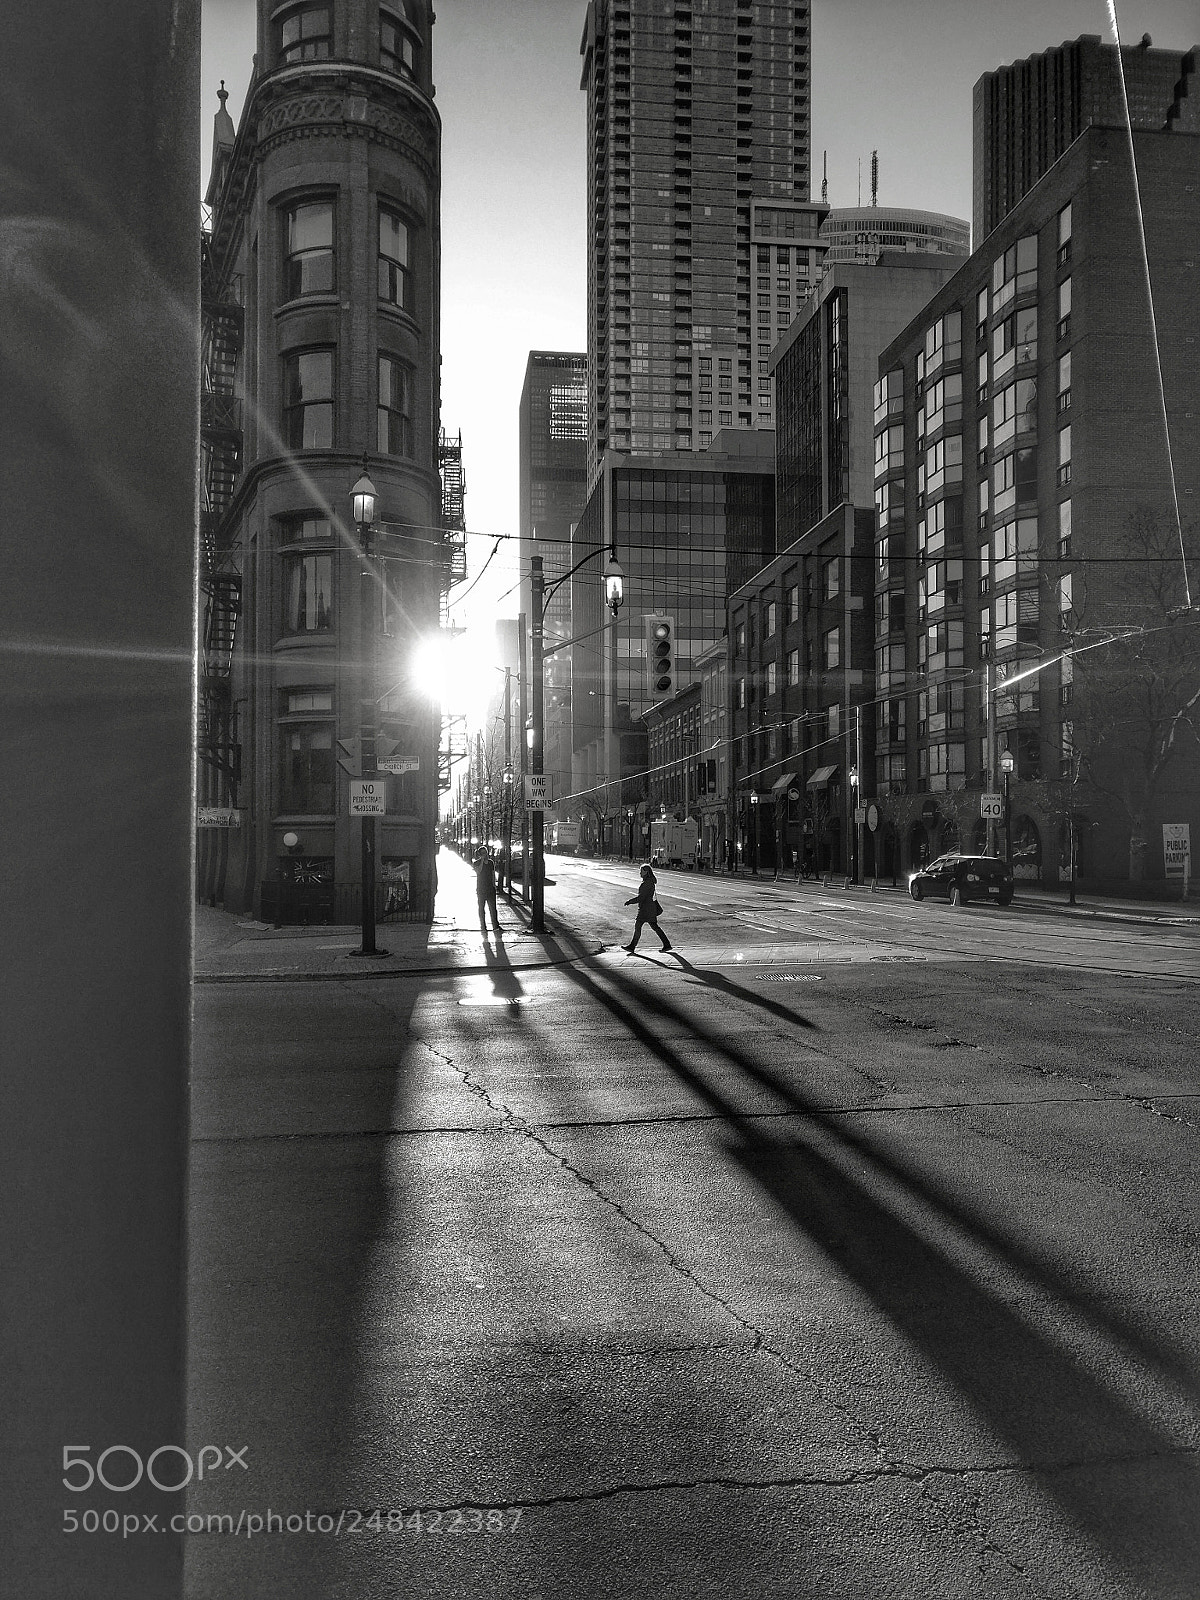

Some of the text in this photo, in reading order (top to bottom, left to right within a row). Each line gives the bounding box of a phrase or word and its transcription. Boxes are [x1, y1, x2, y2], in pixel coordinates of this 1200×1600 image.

[531, 777, 546, 786] ONE
[361, 784, 375, 794] NO
[531, 788, 546, 797] WAY
[526, 799, 552, 808] BEGINS
[983, 804, 1001, 815] 40
[1166, 840, 1188, 850] PUBLIC
